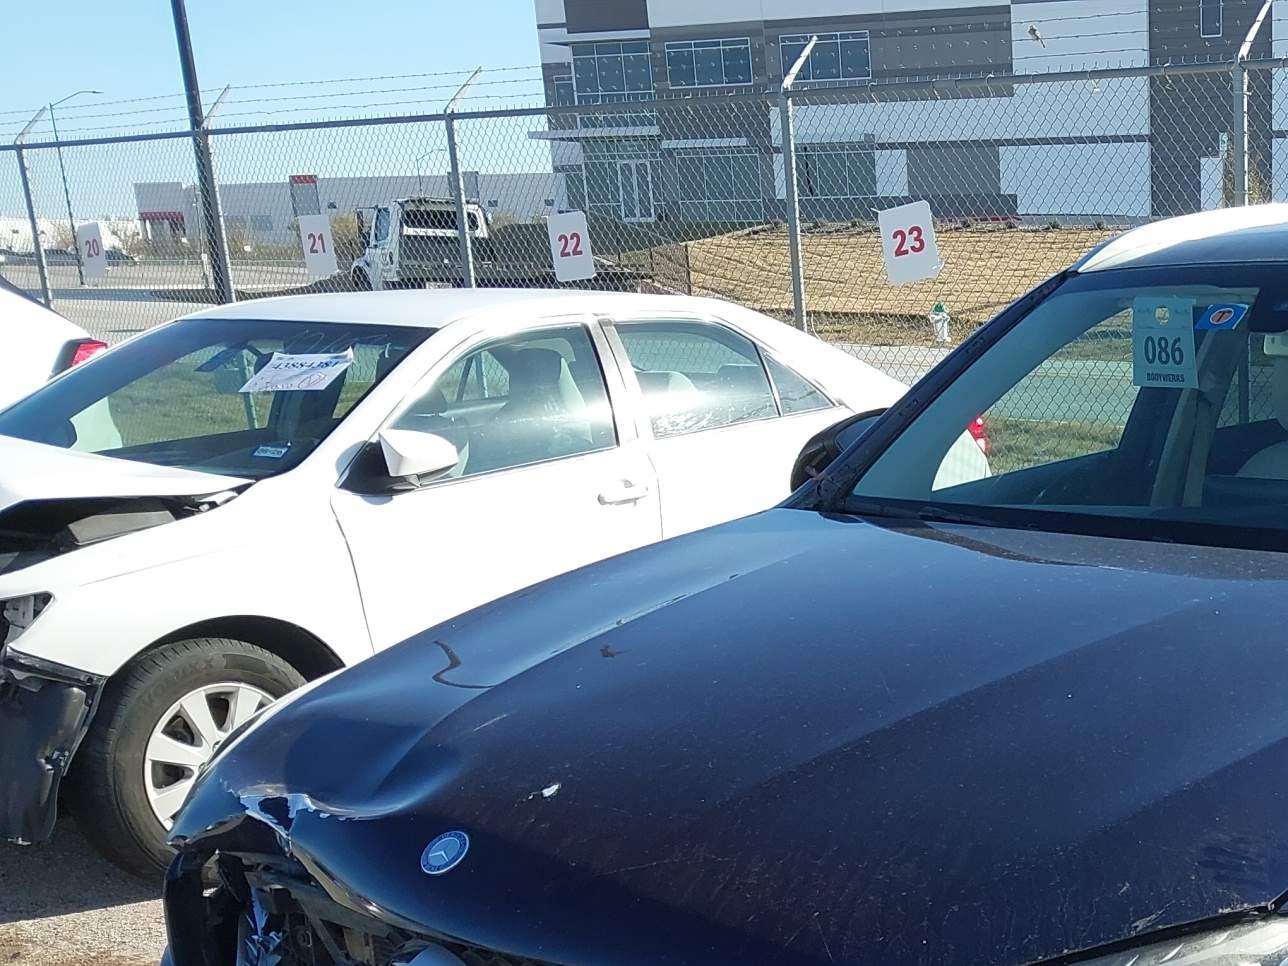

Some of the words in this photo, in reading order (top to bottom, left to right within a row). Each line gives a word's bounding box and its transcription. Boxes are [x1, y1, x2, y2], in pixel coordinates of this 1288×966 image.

[85, 238, 99, 258] 20
[307, 232, 326, 254] 21
[558, 232, 583, 257] 22
[891, 225, 925, 257] 23
[1144, 335, 1184, 366] 086
